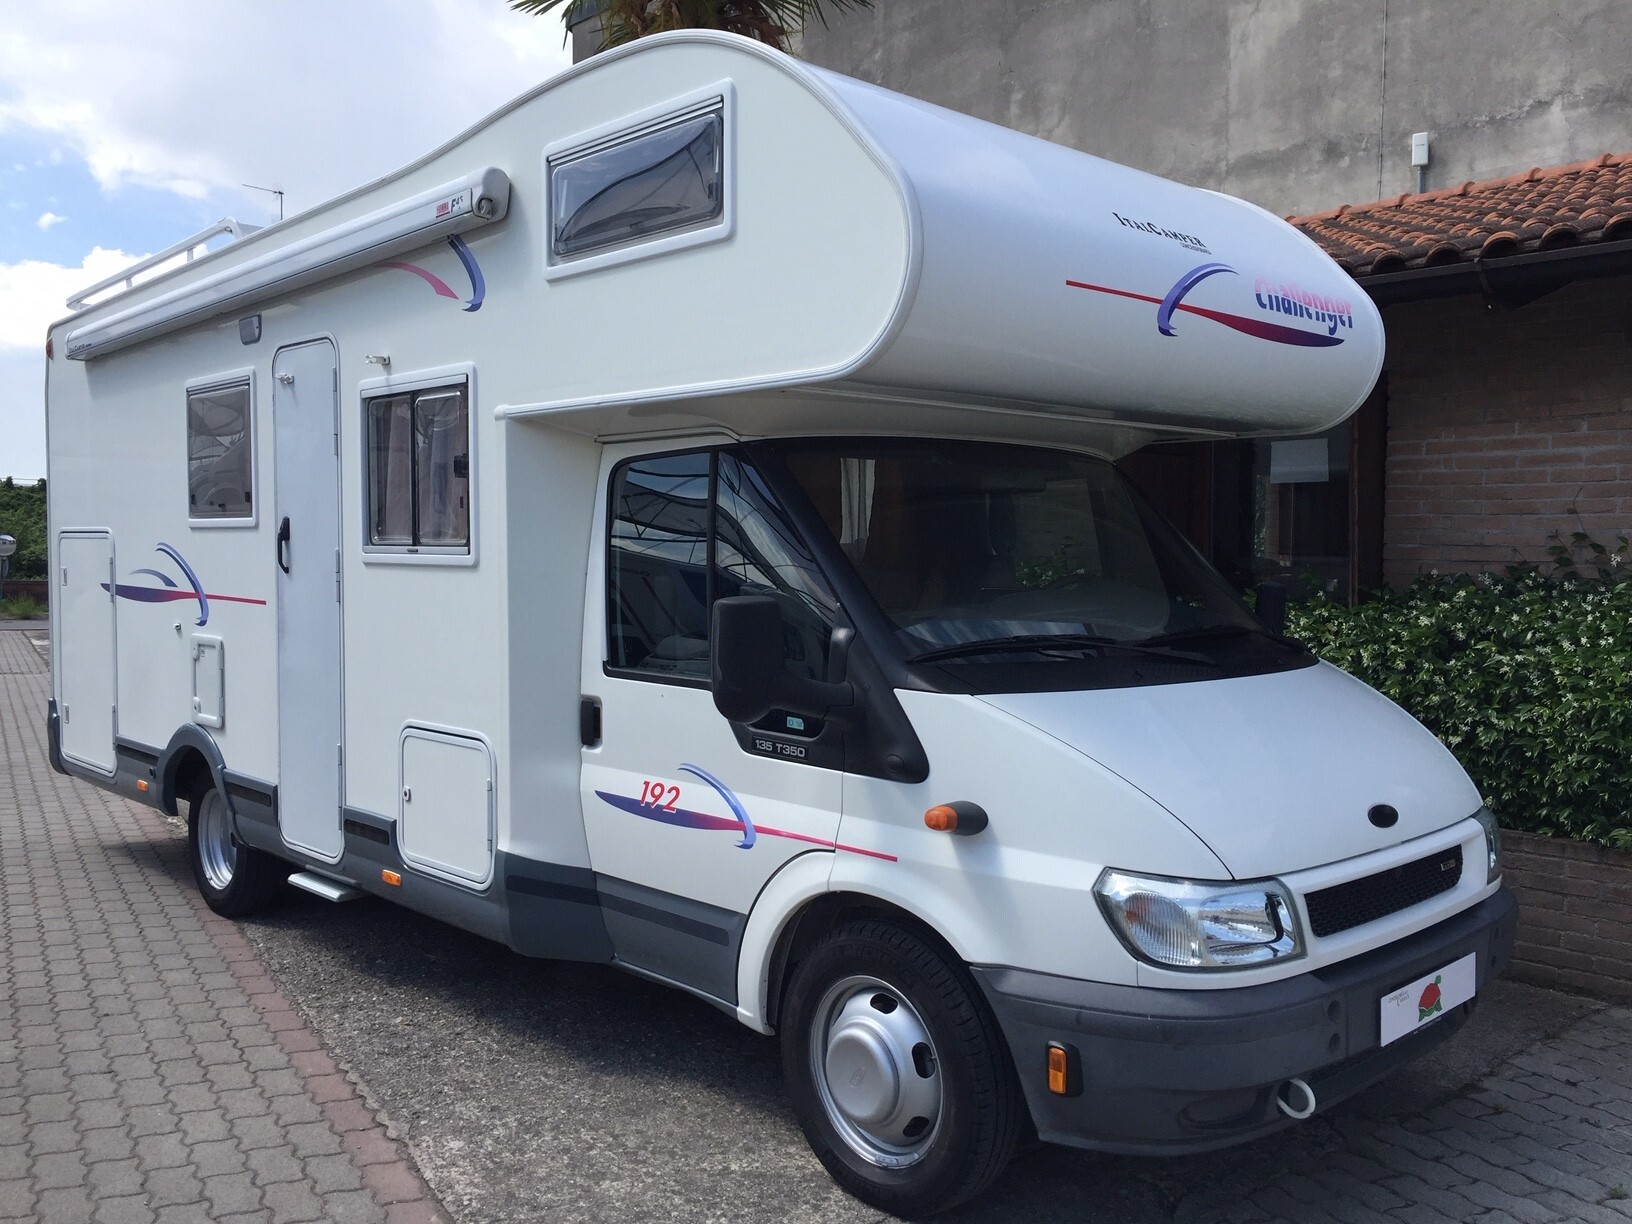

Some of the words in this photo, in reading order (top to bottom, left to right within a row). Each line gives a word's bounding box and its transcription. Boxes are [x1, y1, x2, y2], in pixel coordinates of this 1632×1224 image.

[1255, 275, 1353, 336] Challenger
[755, 739, 773, 752] 135
[775, 743, 806, 758] T350
[641, 780, 681, 813] 192
